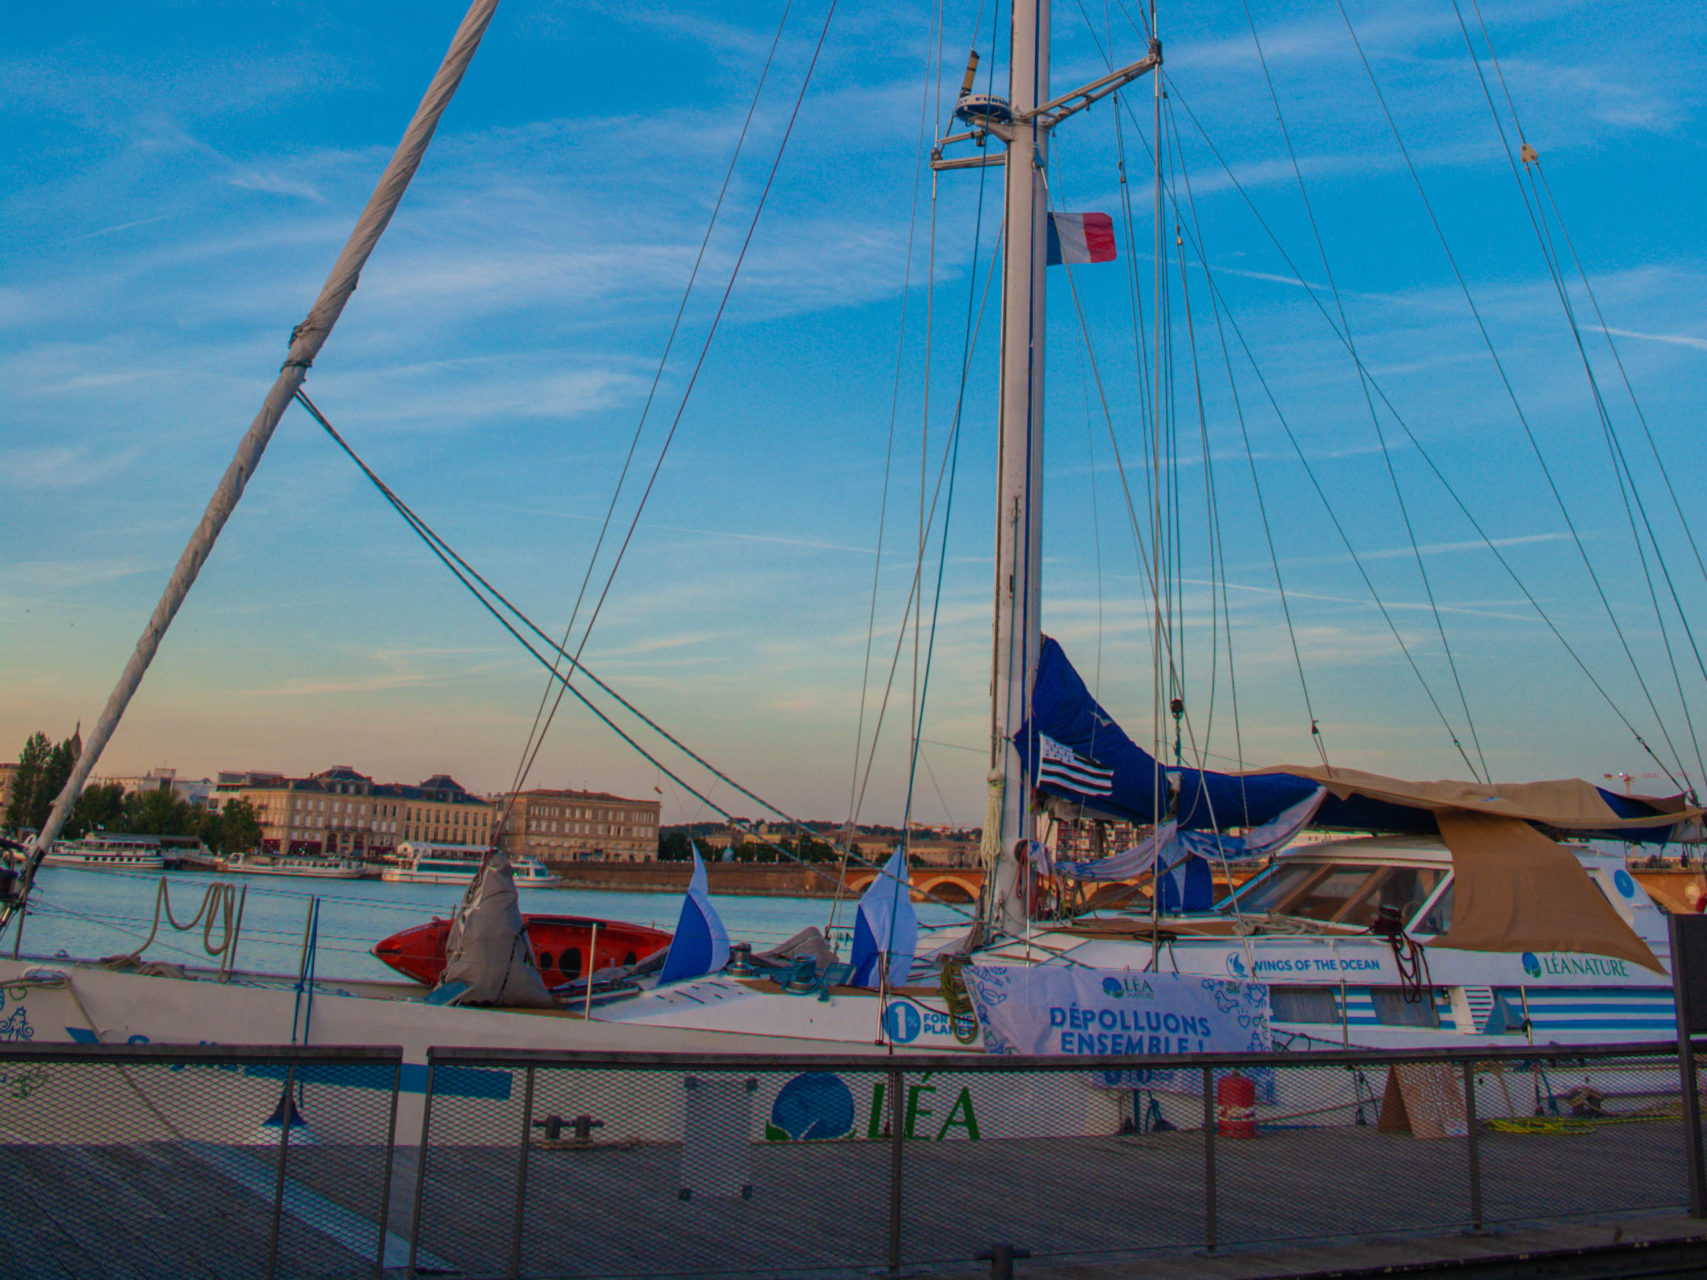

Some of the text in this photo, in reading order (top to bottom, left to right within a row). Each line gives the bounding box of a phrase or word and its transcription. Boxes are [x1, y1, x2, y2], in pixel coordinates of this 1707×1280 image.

[1294, 959, 1311, 971] OF
[1315, 959, 1338, 971] THE
[1340, 959, 1380, 971] OCEAN
[1571, 958, 1629, 977] NATURE
[923, 1013, 949, 1025] FOR
[1050, 1002, 1212, 1037] DÉPOLLUONS
[867, 1071, 981, 1141] LÉA
